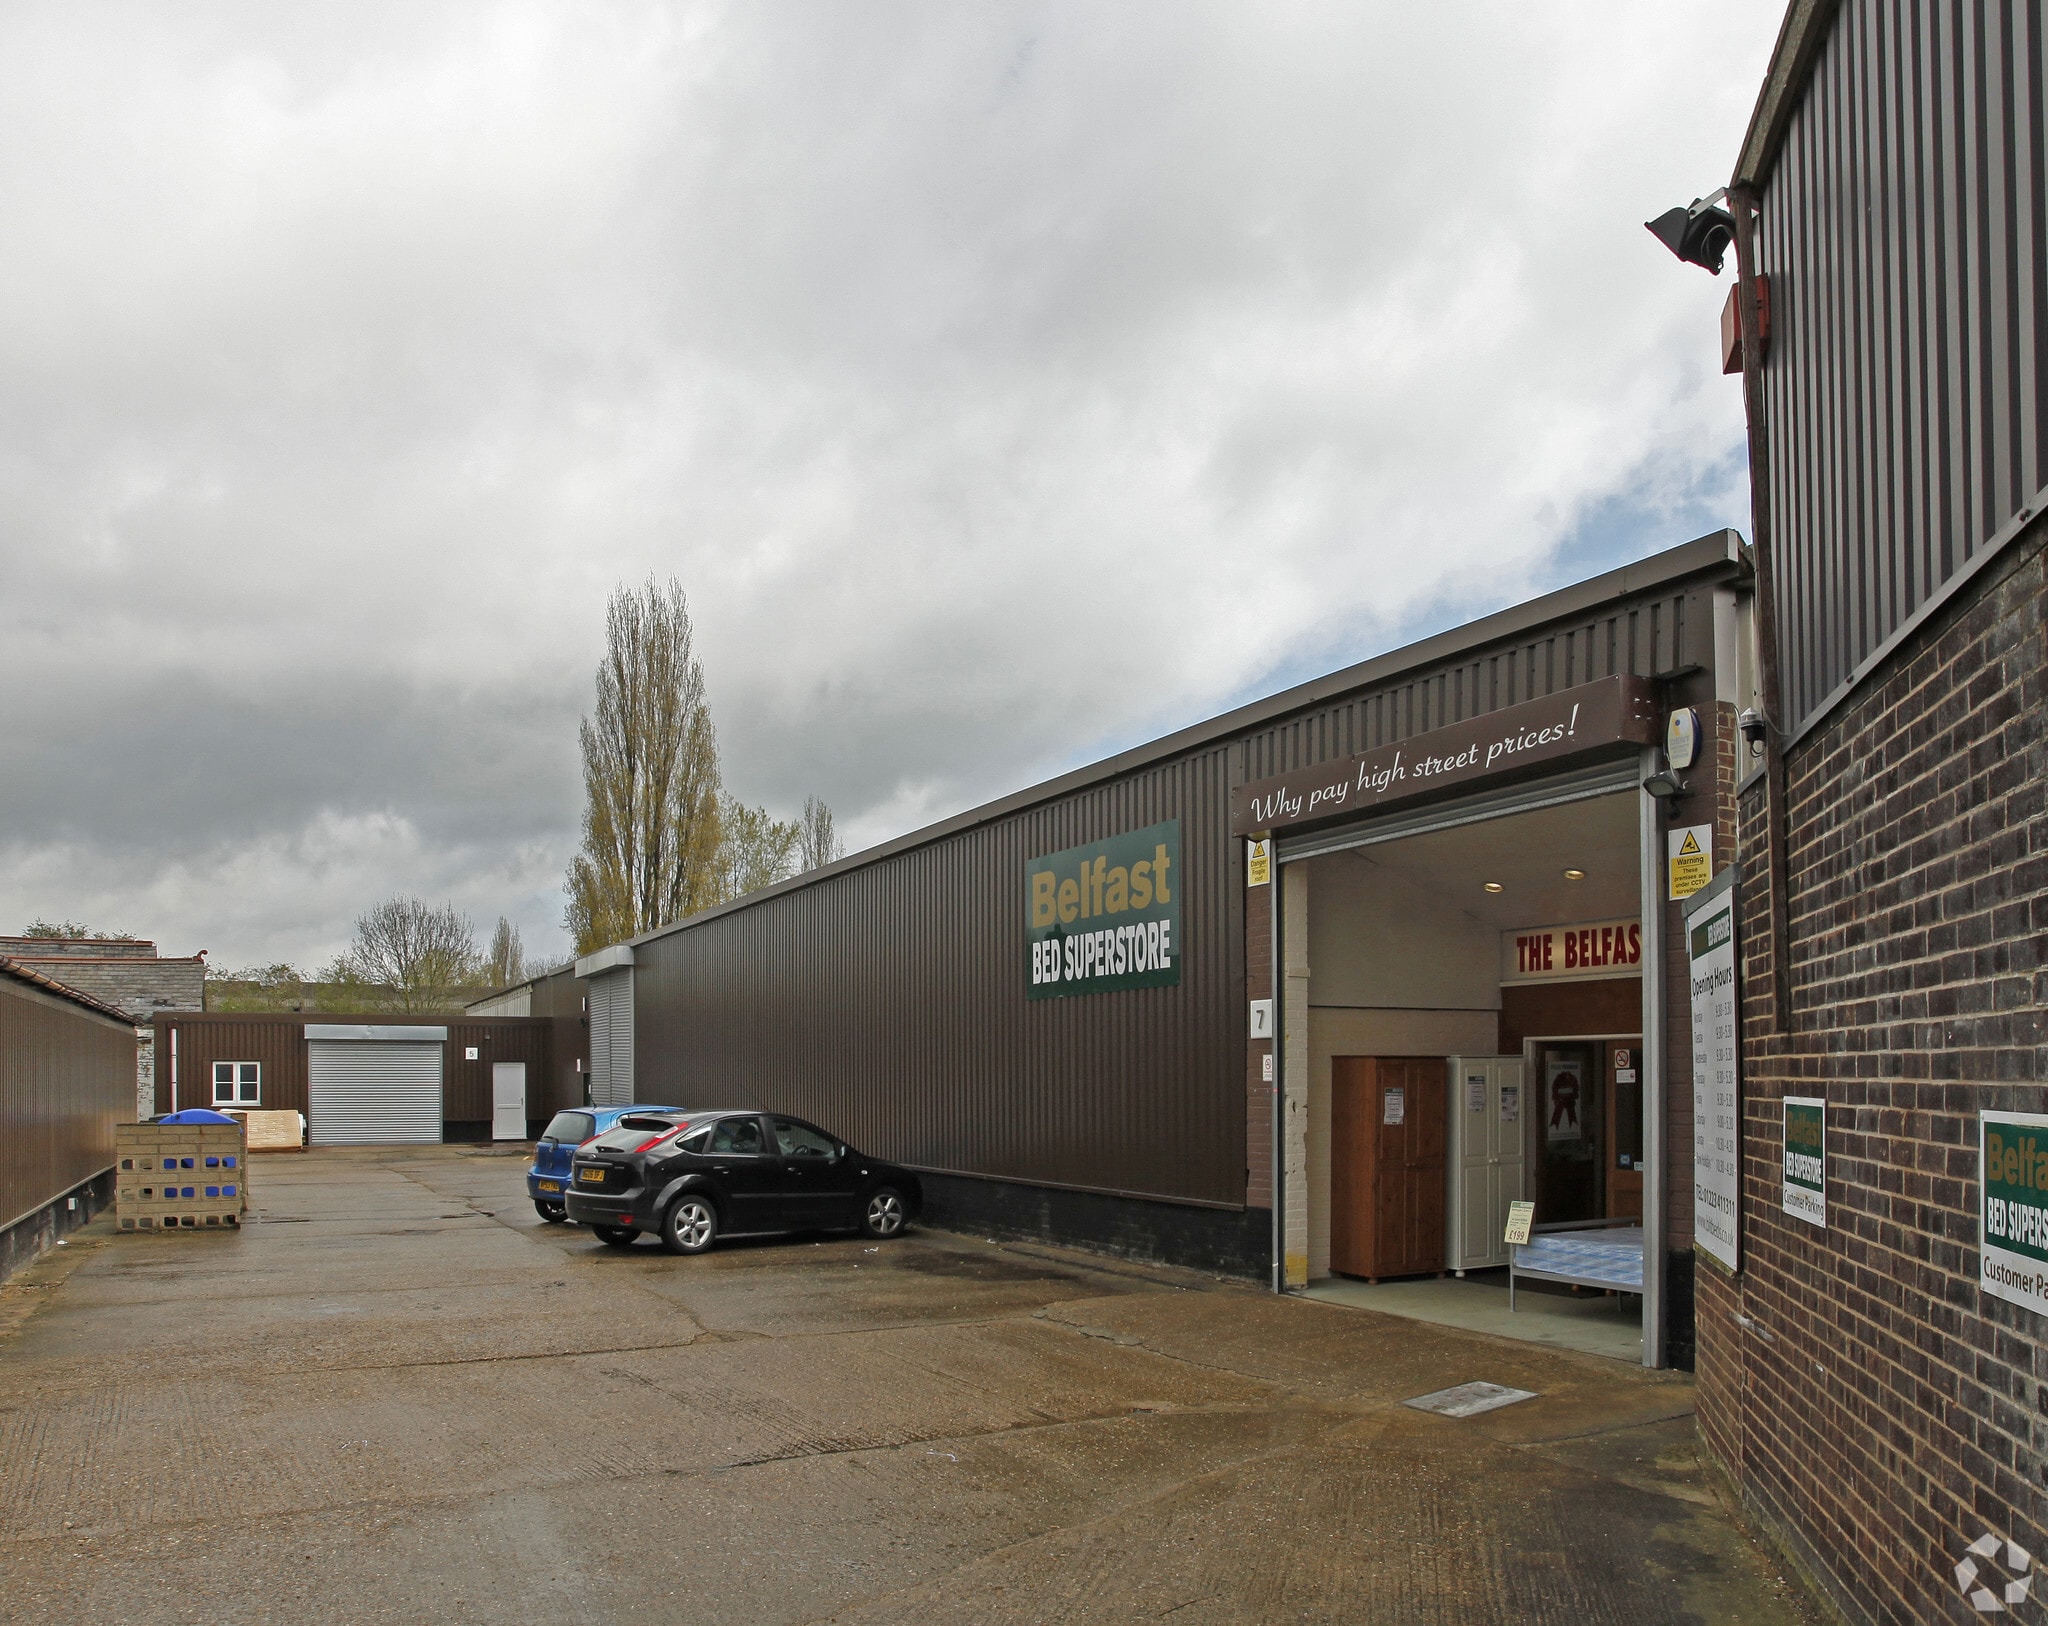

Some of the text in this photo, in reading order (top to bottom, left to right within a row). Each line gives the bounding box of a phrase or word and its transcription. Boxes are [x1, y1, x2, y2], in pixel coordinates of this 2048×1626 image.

[1250, 703, 1580, 822] Why pay high street prices!
[1677, 856, 1704, 866] Warning
[1032, 843, 1171, 929] Belfast
[1032, 919, 1171, 985] BED SUPERSTORE
[1517, 923, 1641, 972] THE BELFAS
[1692, 966, 1732, 1000] Opening Hours
[1256, 1009, 1264, 1030] 7
[469, 1050, 475, 1058] 5
[1786, 1151, 1794, 1177] BED
[1987, 1132, 2048, 1191] Belfa
[1717, 1194, 1735, 1218] 411311
[1784, 1189, 1824, 1220] Customer Parking
[1508, 1229, 1525, 1241] £199
[1987, 1196, 2048, 1250] BED SUPERS
[1983, 1255, 2034, 1296] Customer
